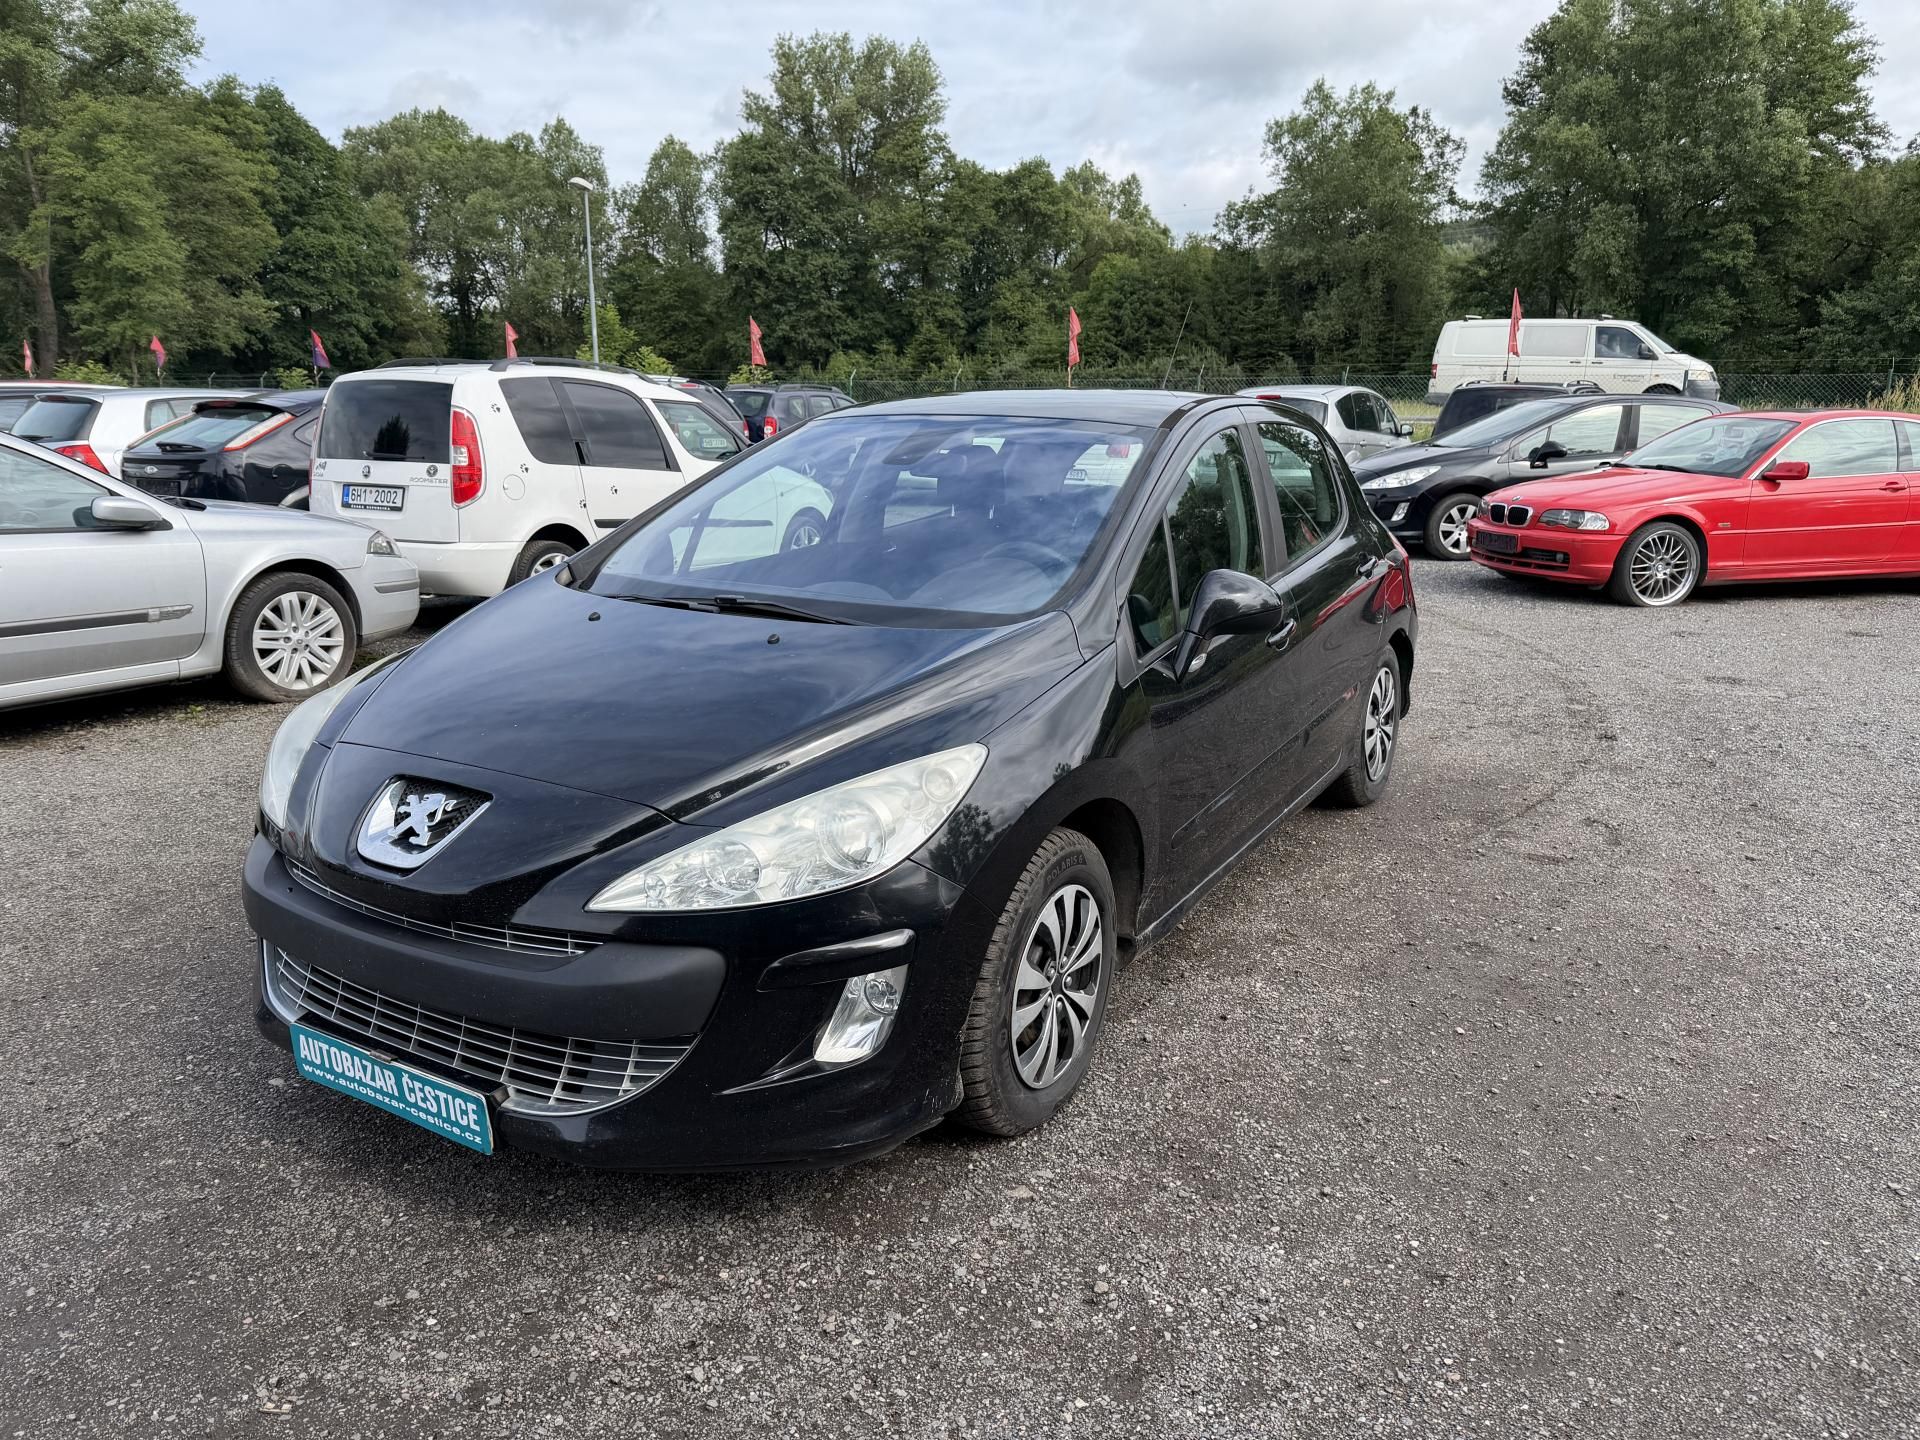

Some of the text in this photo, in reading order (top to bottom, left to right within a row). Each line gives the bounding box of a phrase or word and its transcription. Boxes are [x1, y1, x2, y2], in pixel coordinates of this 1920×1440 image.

[350, 488, 398, 504] 6H1 2002
[1046, 855, 1078, 885] POLARIS
[299, 1034, 481, 1131] AUTOBAZAR ČESTICE
[302, 1063, 483, 1144] www.autobazar-cestice.cz
